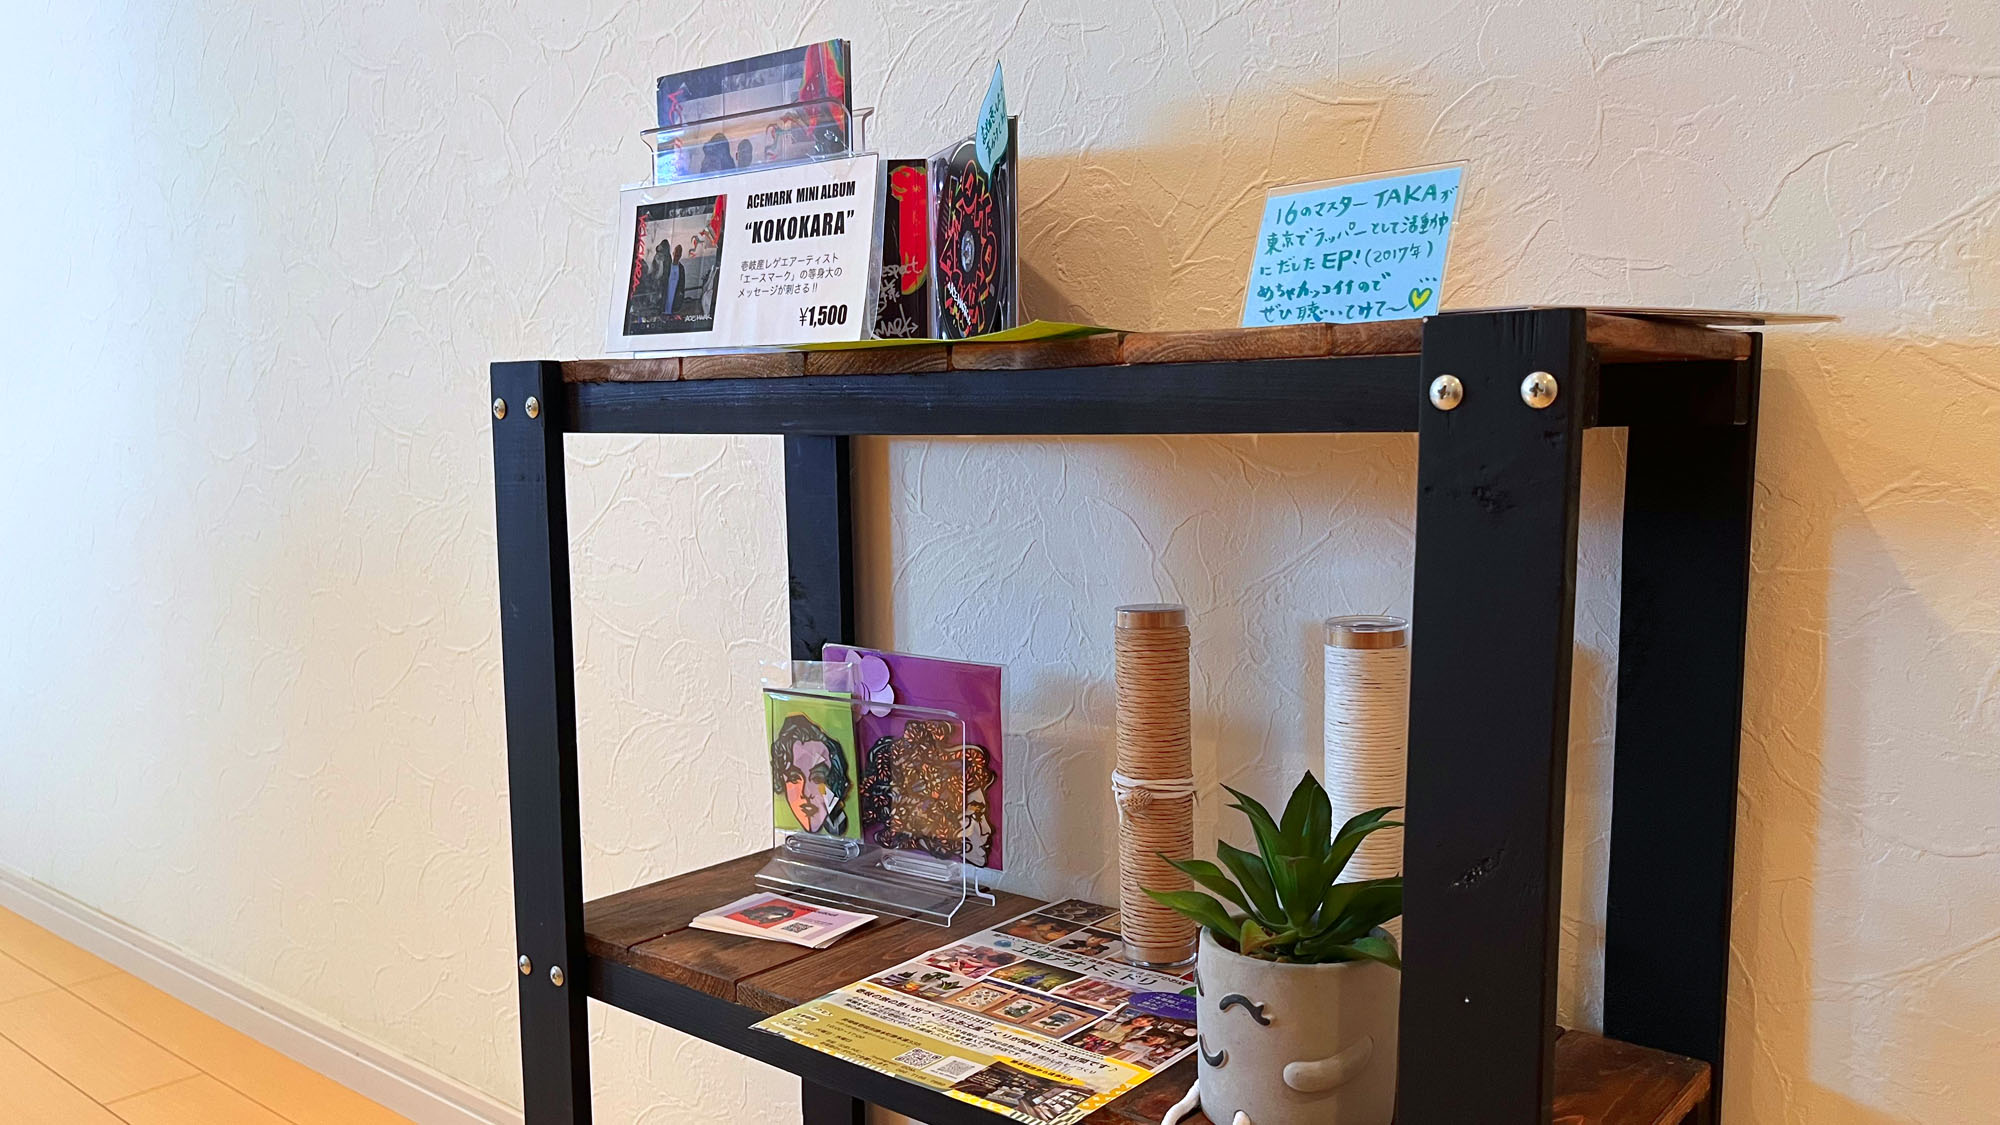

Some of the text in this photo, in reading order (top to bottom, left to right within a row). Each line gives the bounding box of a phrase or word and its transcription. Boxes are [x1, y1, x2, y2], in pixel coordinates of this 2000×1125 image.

[747, 181, 856, 210] ACEMARK MINI ALBUM
[1264, 211, 1450, 256] 東京でラッパーとして活動中
[740, 253, 839, 272] 壱岐産レゲエアーティスト
[739, 267, 843, 285] 「エースマーク」の等身大の
[799, 304, 848, 328] ¥1,500
